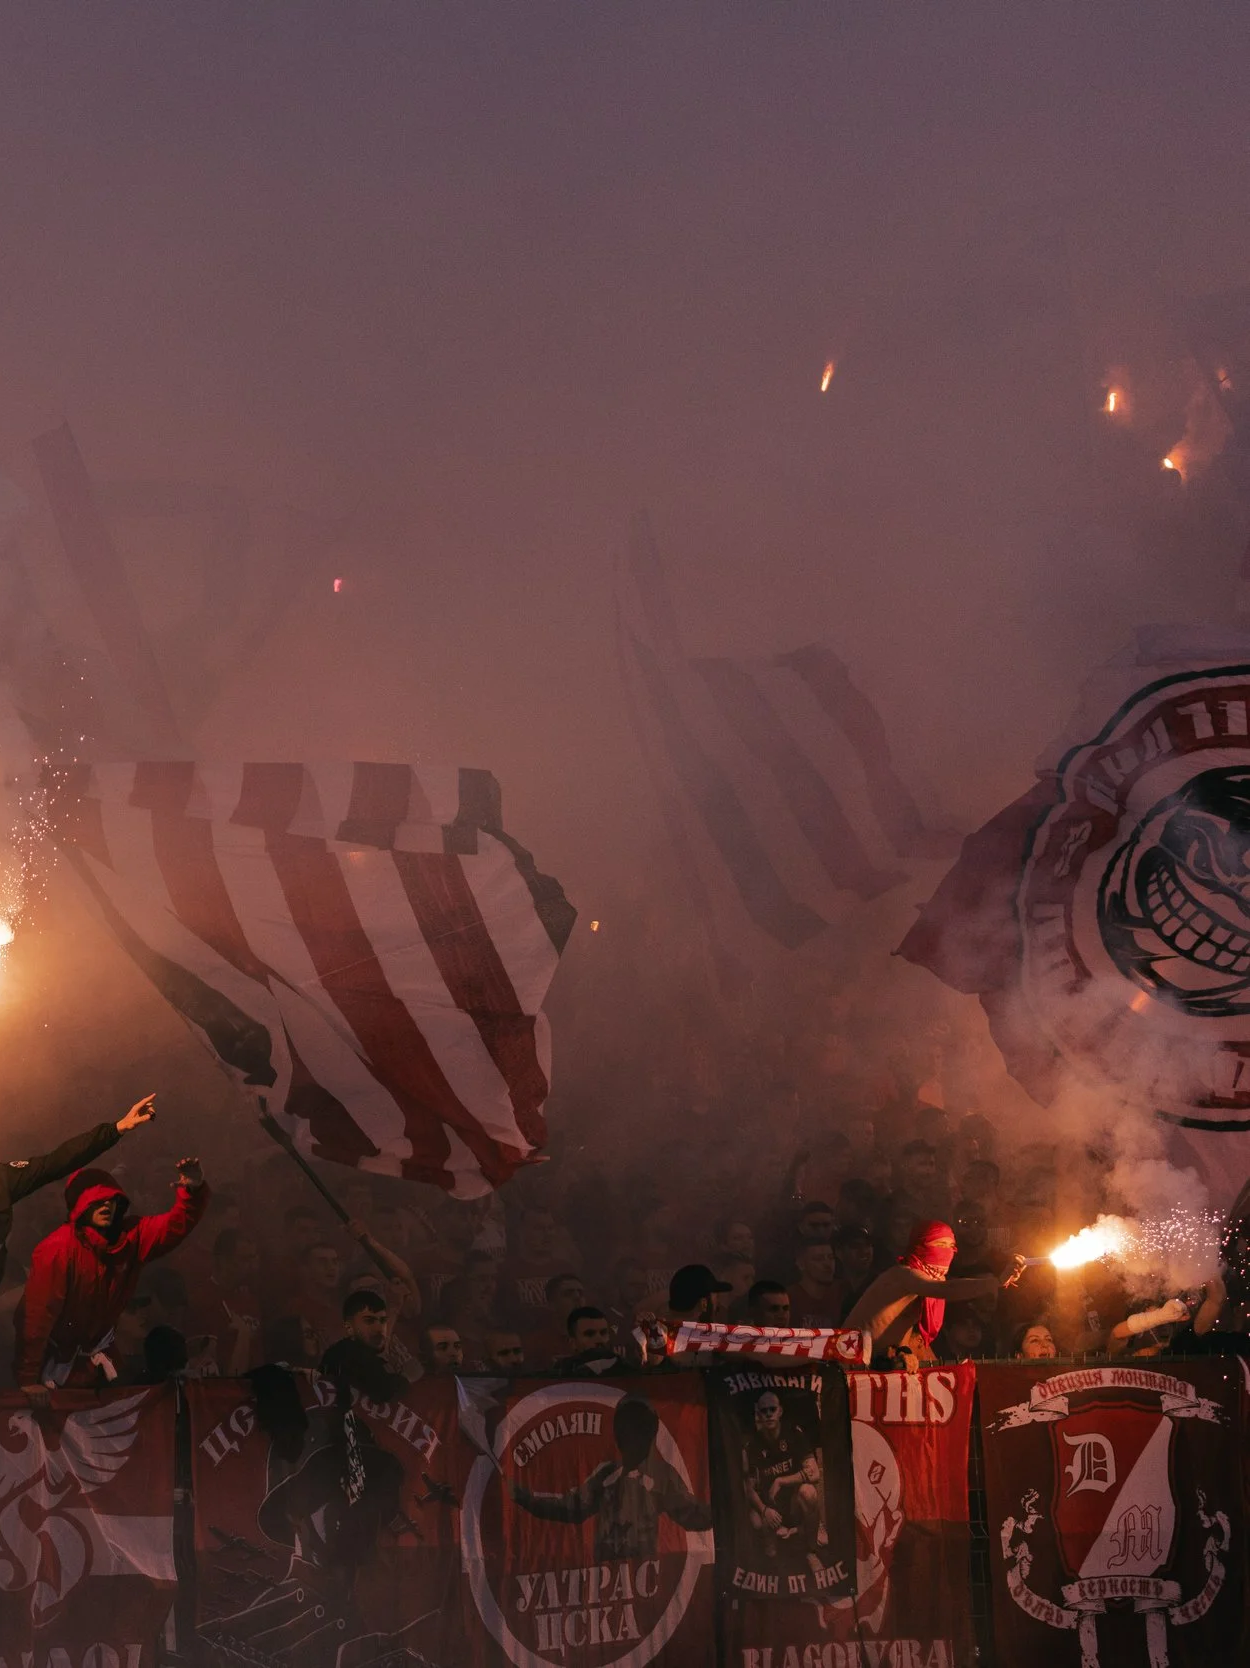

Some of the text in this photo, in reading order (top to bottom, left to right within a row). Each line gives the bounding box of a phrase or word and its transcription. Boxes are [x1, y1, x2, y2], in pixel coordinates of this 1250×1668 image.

[512, 1410, 603, 1468] СМОЛЯН
[1062, 1431, 1117, 1498] D
[515, 1559, 660, 1612] УЛТРАС
[731, 1561, 849, 1594] ЕДИН ОТ НАС
[534, 1604, 641, 1657] ЦСКА
